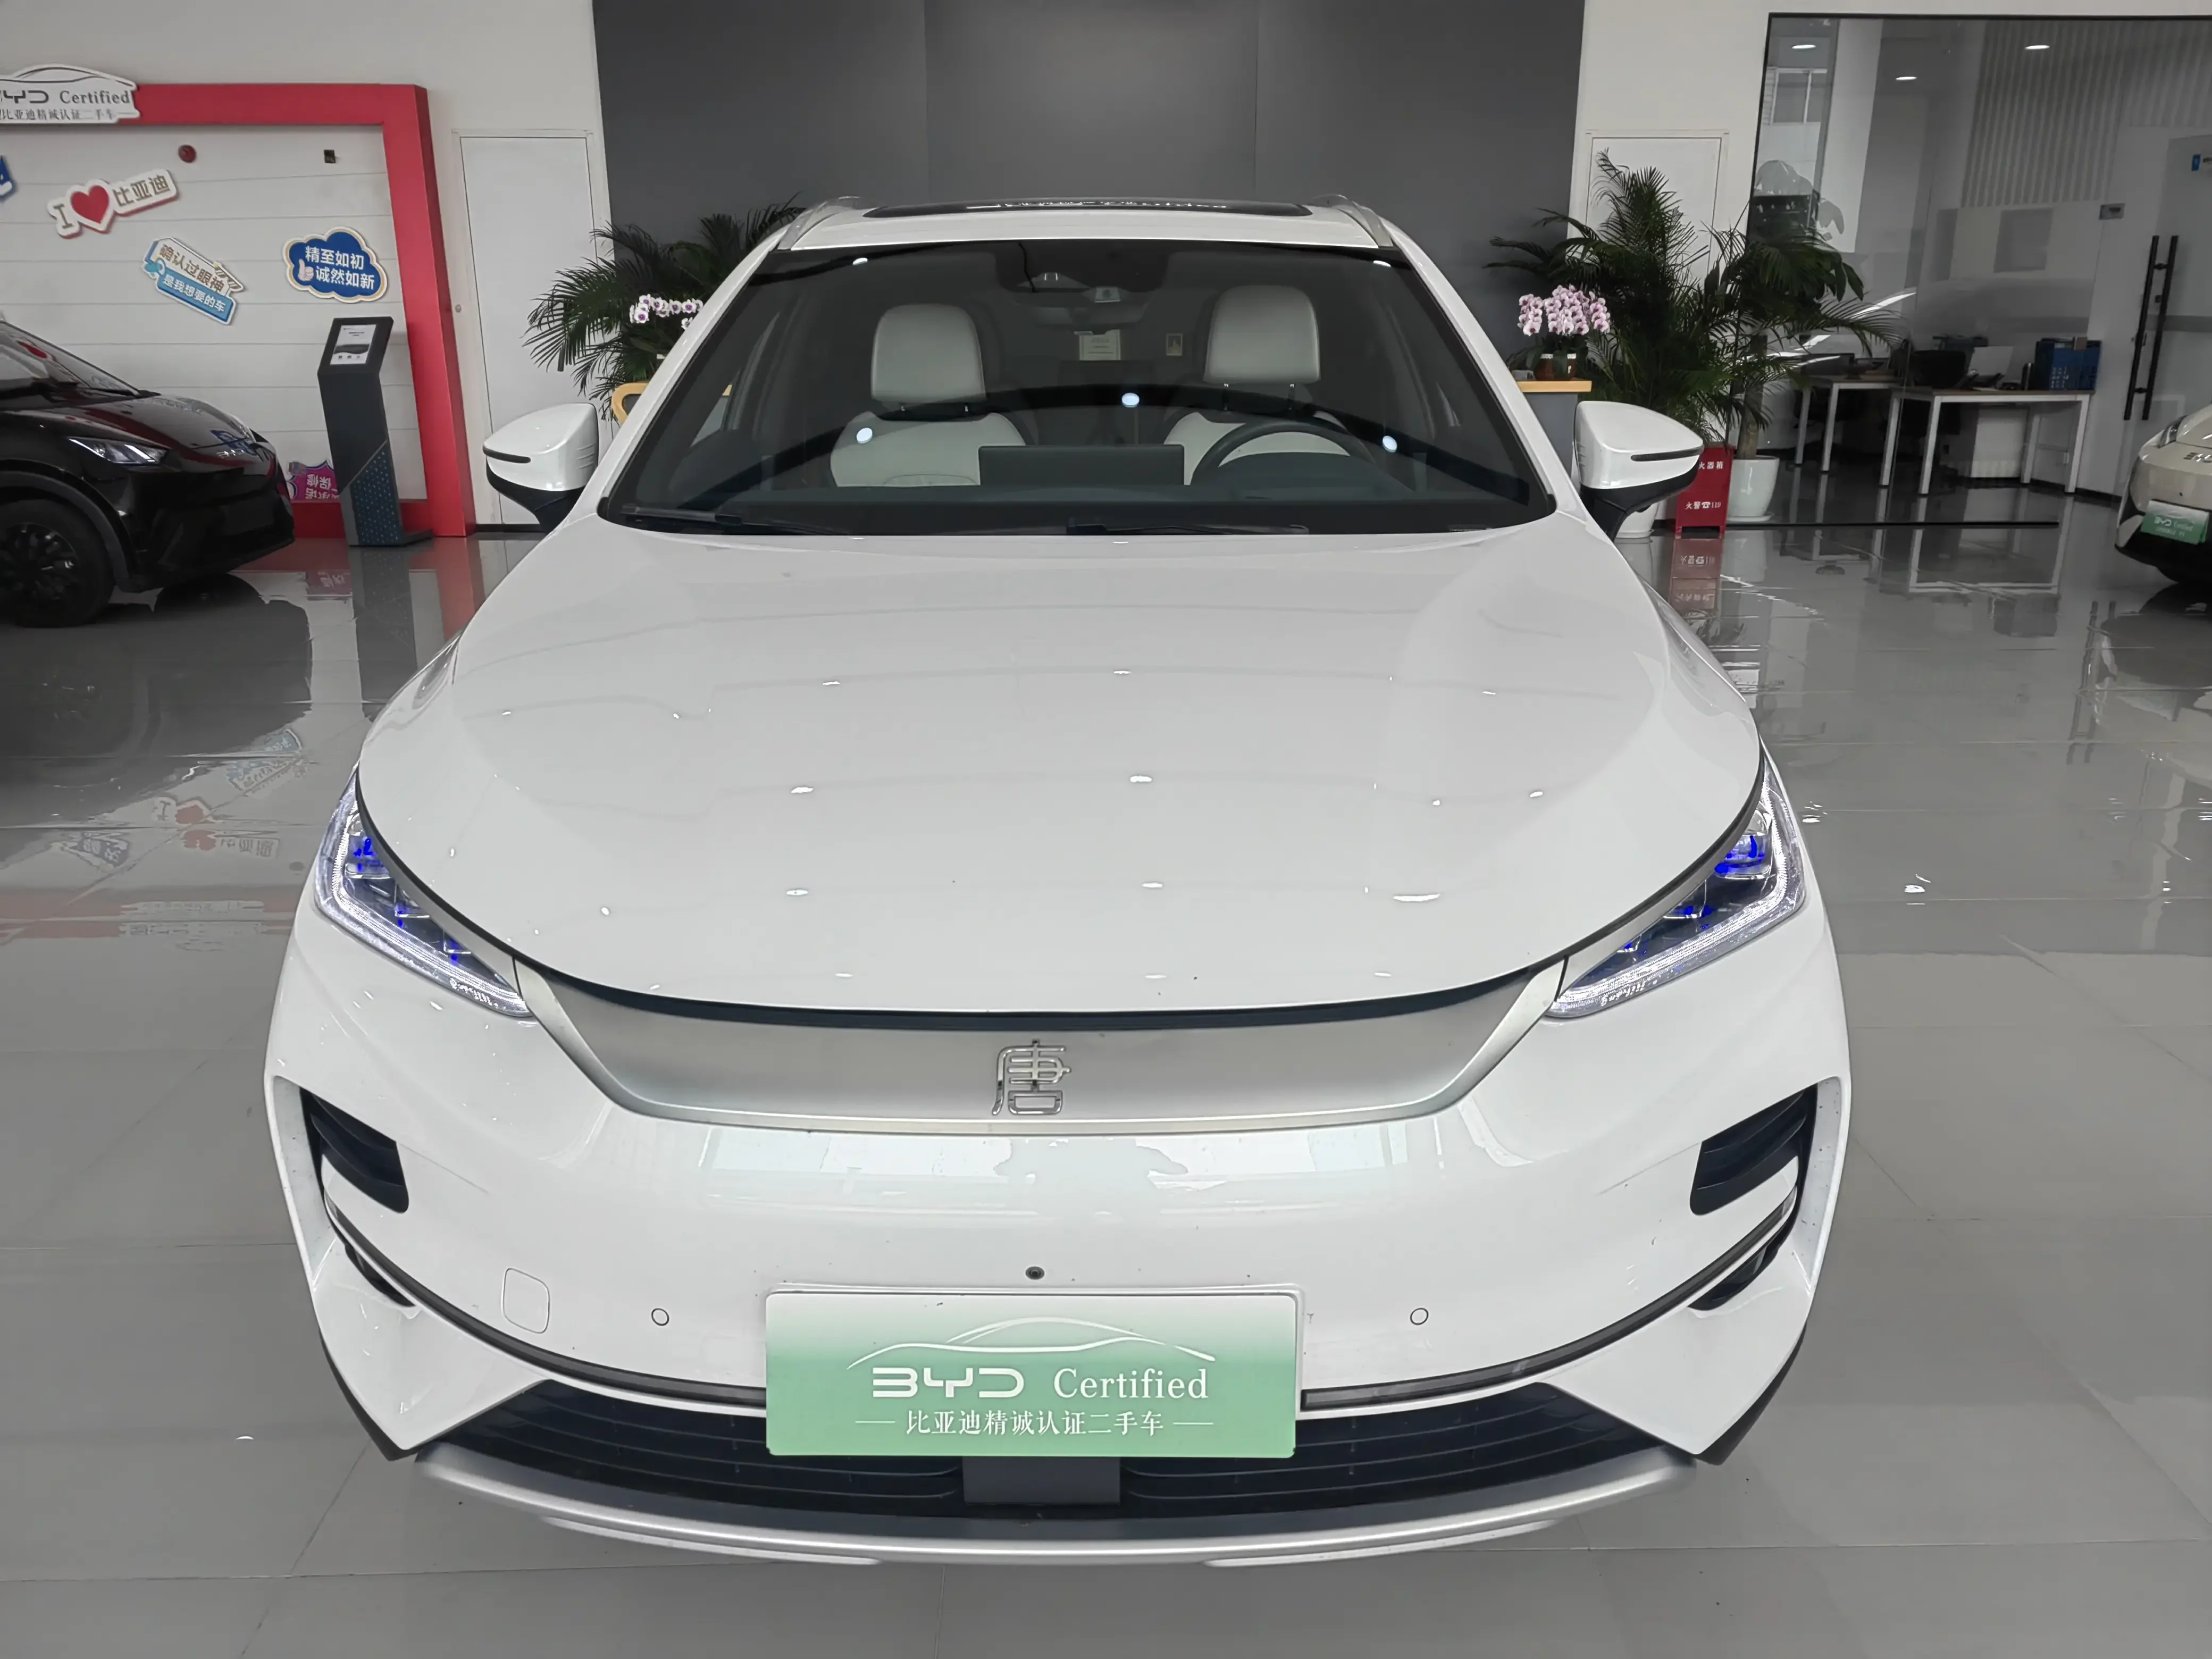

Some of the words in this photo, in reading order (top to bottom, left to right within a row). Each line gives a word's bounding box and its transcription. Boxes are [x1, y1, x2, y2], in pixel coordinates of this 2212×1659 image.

[0, 90, 49, 104] YD
[60, 90, 130, 104] Certified
[53, 203, 73, 229] I
[112, 174, 170, 207] 比亚迪
[160, 244, 224, 292] 确认过眼神
[305, 246, 364, 270] 精至如初
[163, 274, 226, 312] 是我想要的车
[316, 266, 374, 290] 诚然如新
[992, 1038, 1071, 1116] 唐
[873, 1367, 1025, 1398] BYD
[1053, 1368, 1209, 1400] Certified
[906, 1410, 1164, 1436] 比亚迪精诚认证二手车
